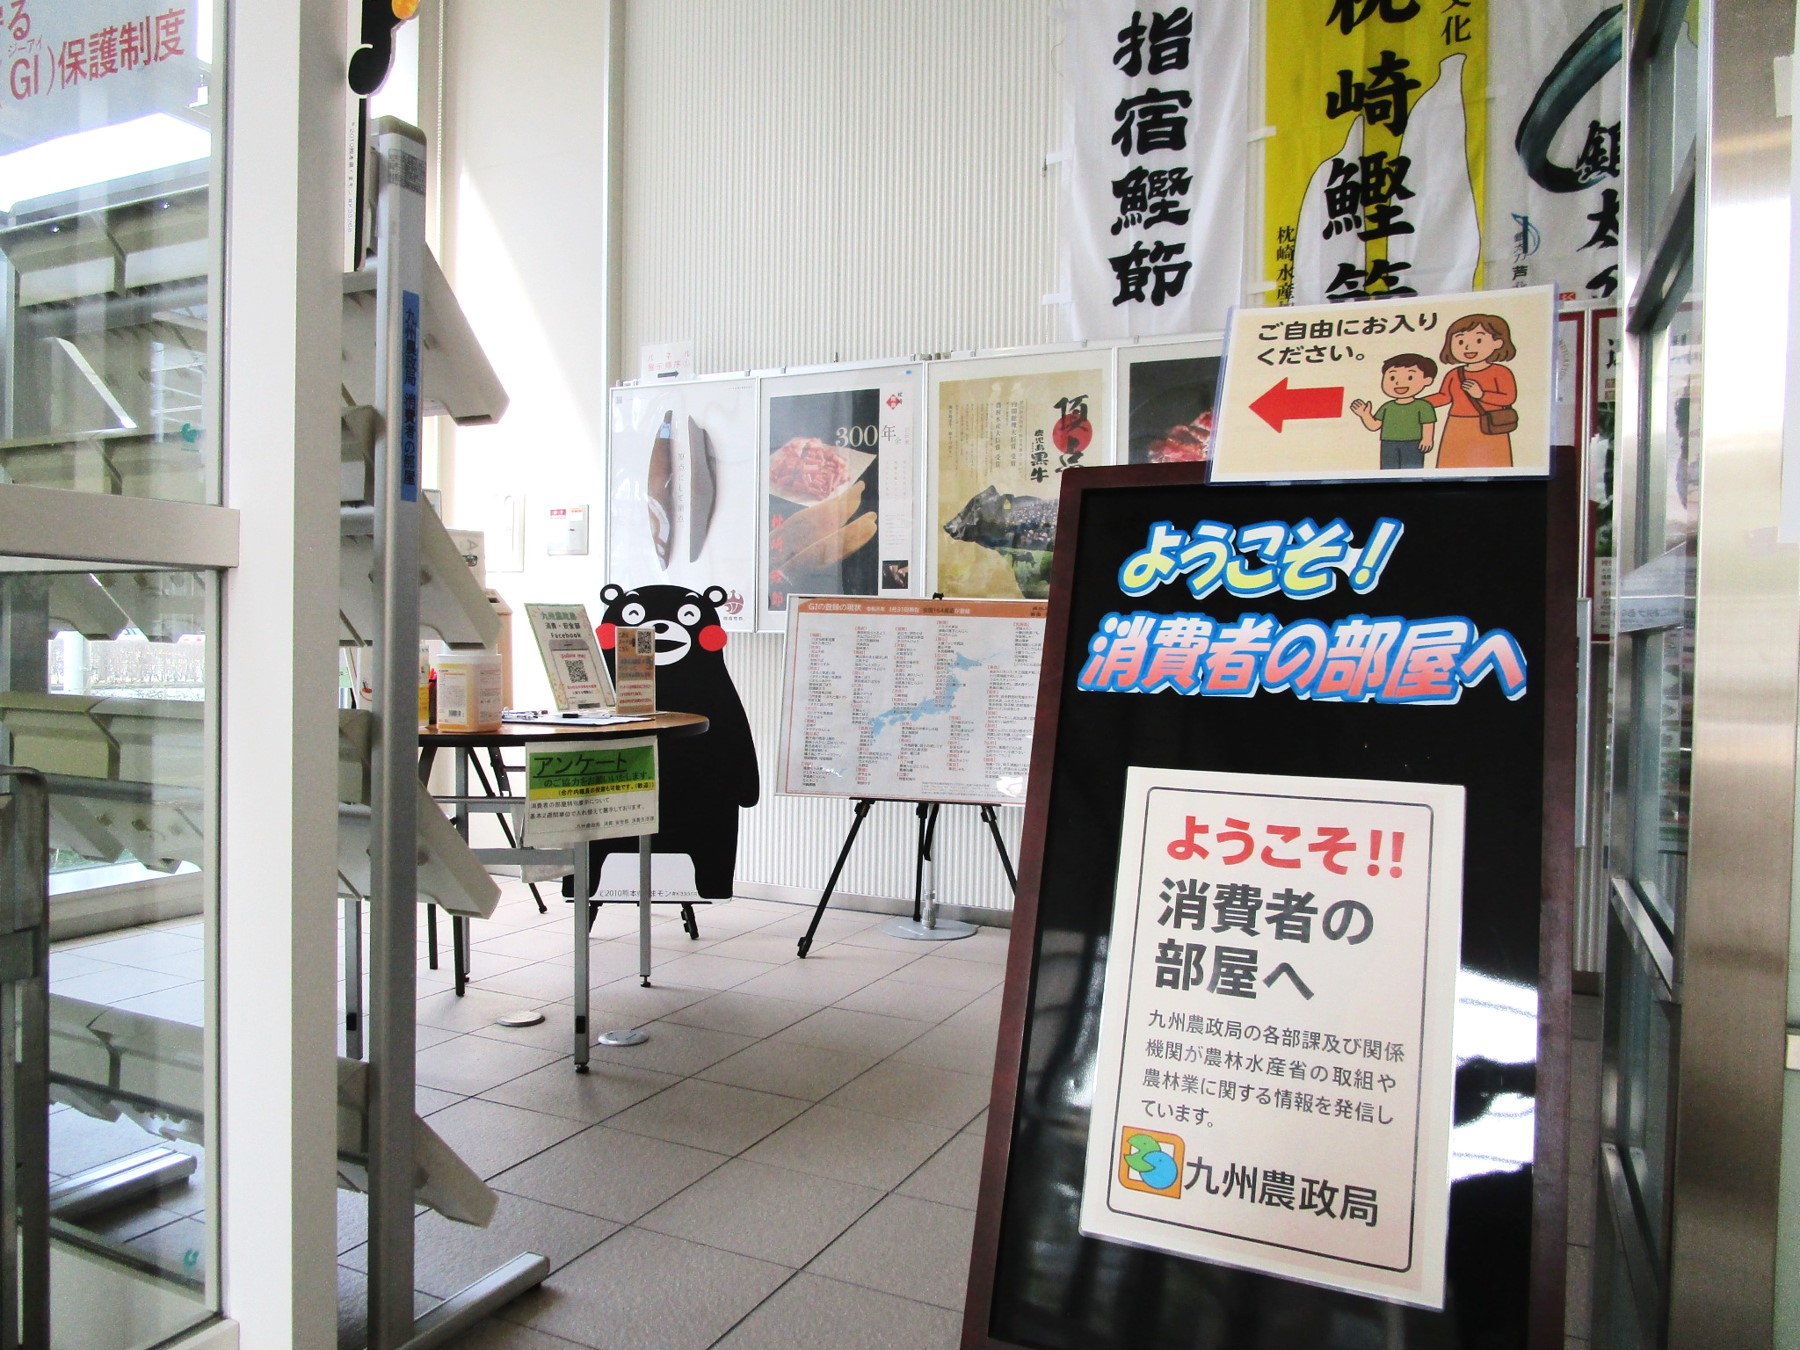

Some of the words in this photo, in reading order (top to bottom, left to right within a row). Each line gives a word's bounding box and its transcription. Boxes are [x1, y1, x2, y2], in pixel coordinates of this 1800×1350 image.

[0, 0, 31, 41] る
[8, 35, 43, 57] ジーアイ
[1108, 7, 1193, 306] 指宿鰹節
[1276, 225, 1295, 307] 枕崎水産
[404, 308, 417, 386] 九州農政局
[1257, 345, 1366, 366] ください。
[1258, 312, 1438, 341] ご自由にお入り
[403, 393, 417, 486] 消費者の部屋
[1119, 517, 1404, 599] ようこそ!
[1078, 612, 1527, 704] 消費者の部屋へ
[533, 752, 627, 775] アンケート
[1167, 815, 1405, 879] ようこそ!!
[1157, 877, 1374, 945] 消費者の
[1155, 938, 1314, 1000] 部屋へ
[1146, 1038, 1397, 1094] 機関が農林水産省の取組や
[1148, 1009, 1404, 1063] 九州農政局の各部課及び関係
[1141, 1098, 1214, 1128] ています。
[1142, 1068, 1394, 1125] 農林業に関する情報を発信し
[1183, 1155, 1378, 1227] 九州農政局
